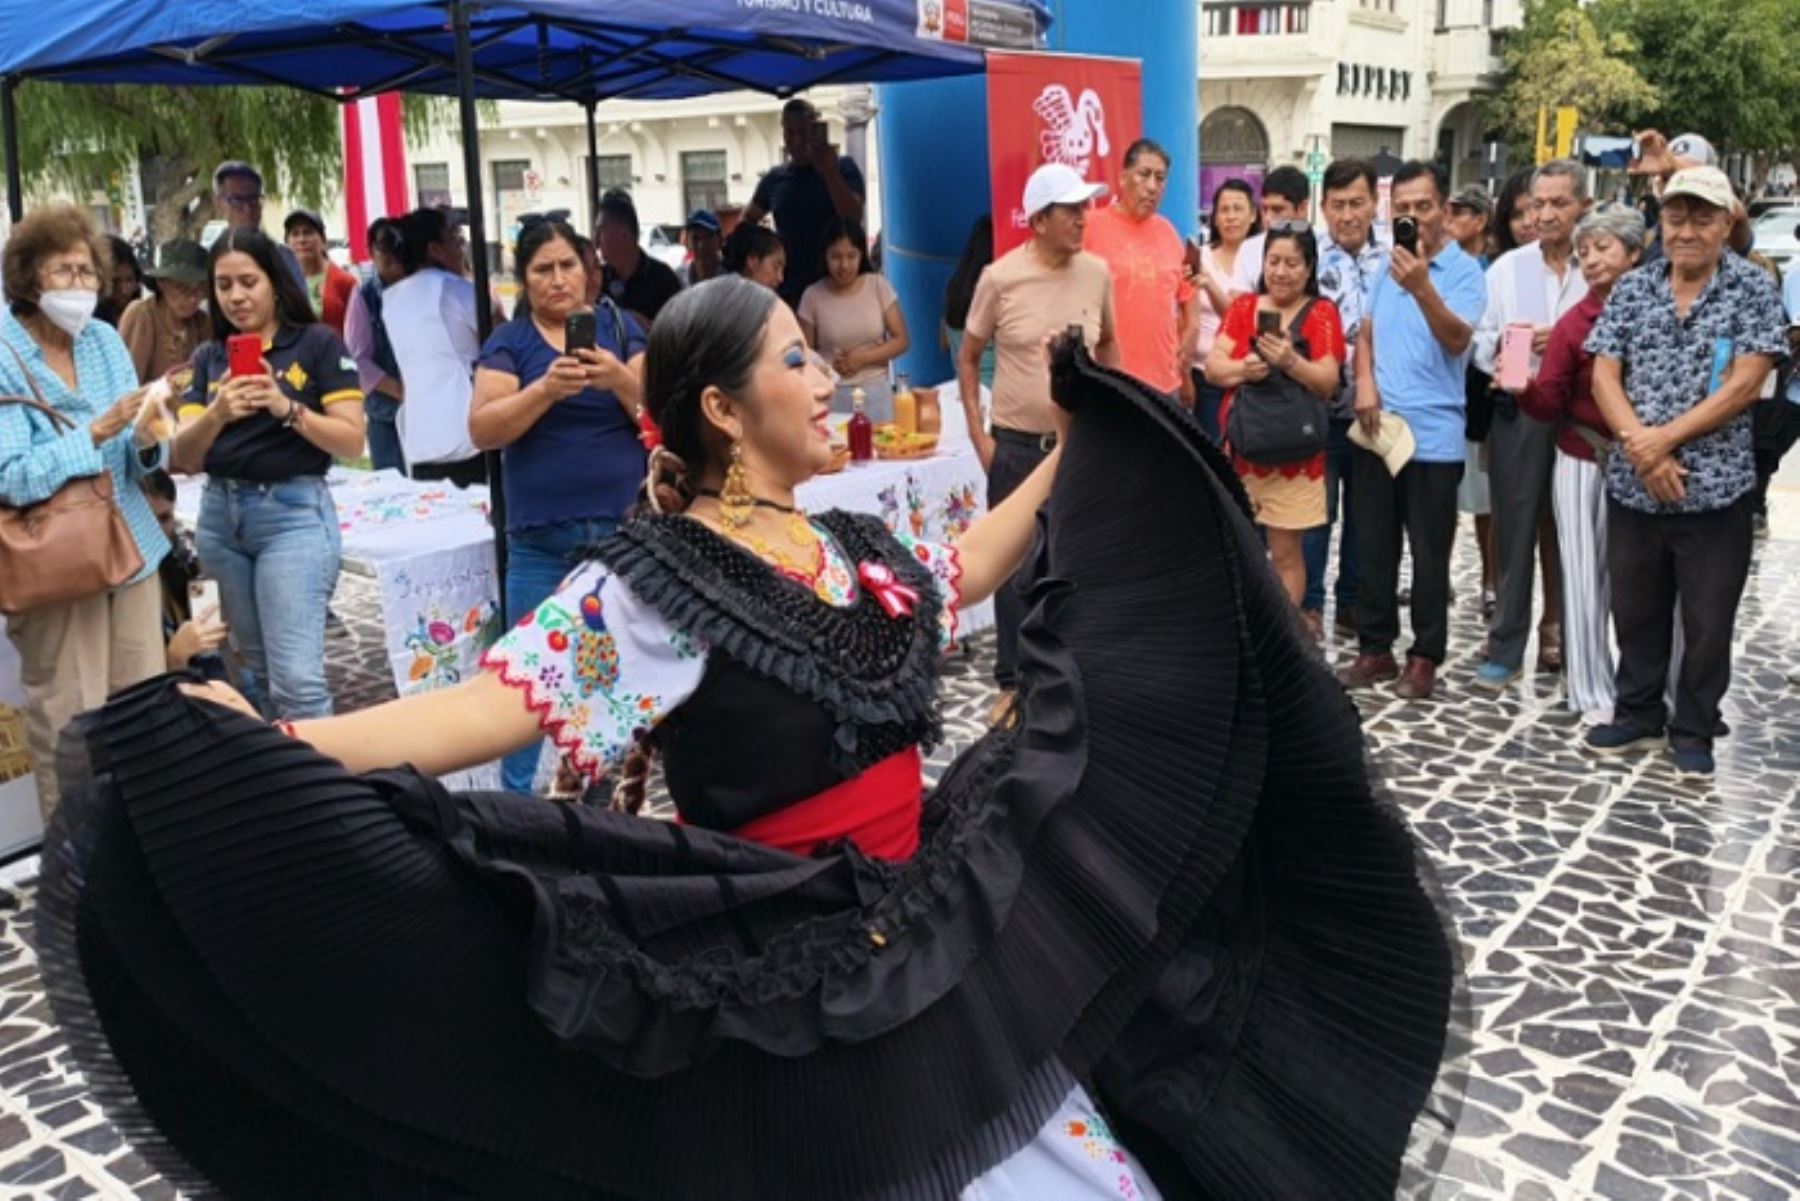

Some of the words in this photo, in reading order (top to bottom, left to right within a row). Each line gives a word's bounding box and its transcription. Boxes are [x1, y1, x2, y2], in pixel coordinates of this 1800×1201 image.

[803, 0, 811, 13] Y
[814, 0, 874, 23] CULTURA
[1336, 61, 1414, 102] RIPLEY
